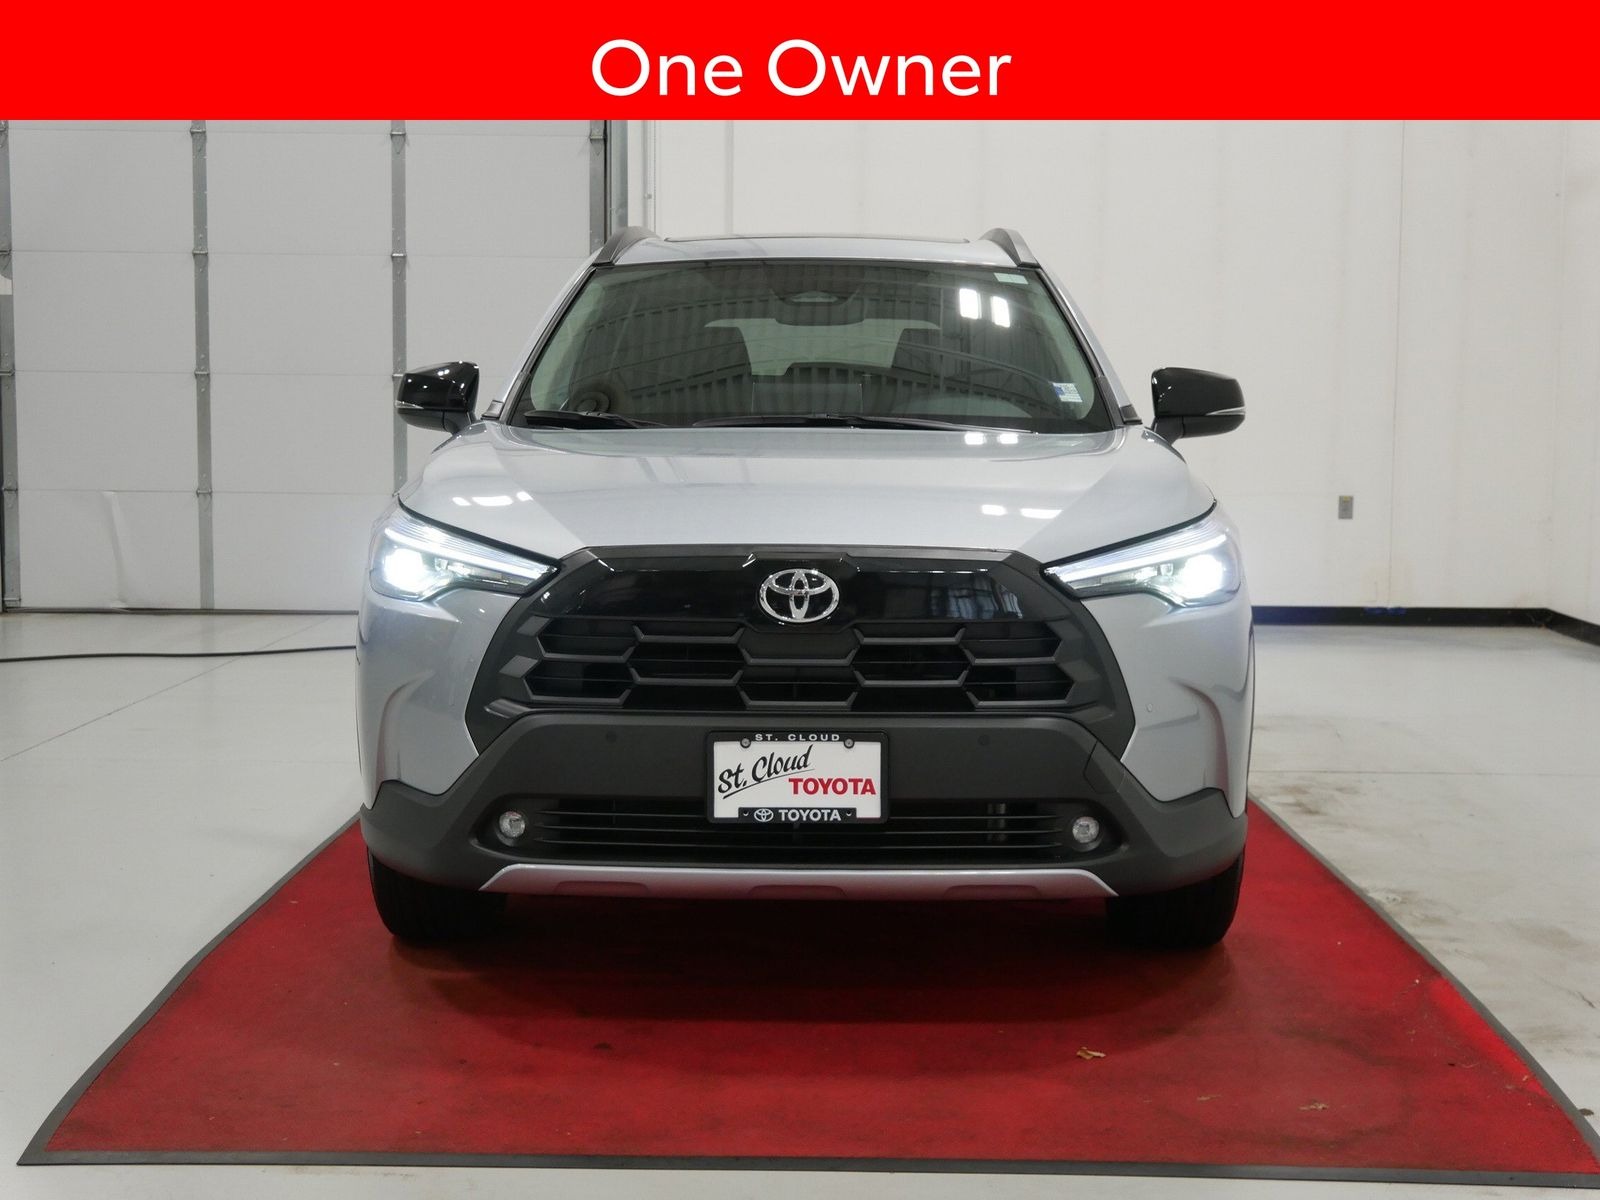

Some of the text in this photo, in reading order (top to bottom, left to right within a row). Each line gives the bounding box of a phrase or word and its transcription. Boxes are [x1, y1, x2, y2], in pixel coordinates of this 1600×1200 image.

[754, 733, 840, 742] ST. CLOUD
[718, 744, 813, 793] St. Cloud
[789, 778, 876, 795] TOYOTA
[778, 809, 841, 821] TOYOTA
